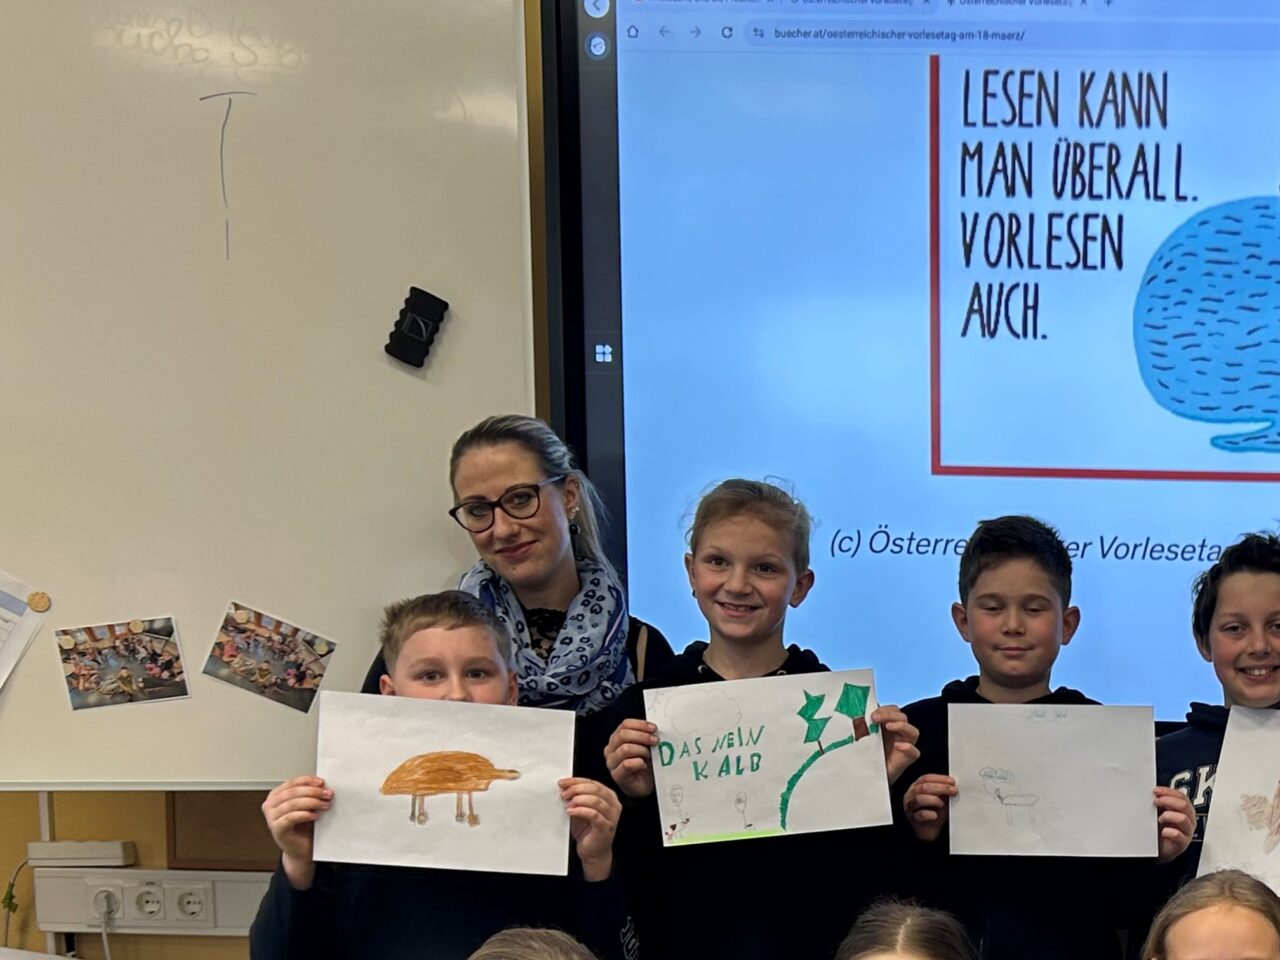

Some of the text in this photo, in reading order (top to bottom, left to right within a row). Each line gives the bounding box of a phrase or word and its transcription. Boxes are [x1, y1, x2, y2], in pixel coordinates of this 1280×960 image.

[963, 69, 1168, 129] LESEN KANN
[960, 137, 1198, 202] MAN ÜBERALL.
[960, 211, 1124, 271] VORLESEN
[960, 281, 1048, 340] AUCH.
[830, 529, 861, 558] (c)
[1099, 536, 1224, 562] Vorleseta
[658, 725, 765, 767] DAS NEIN
[692, 752, 762, 781] KALB
